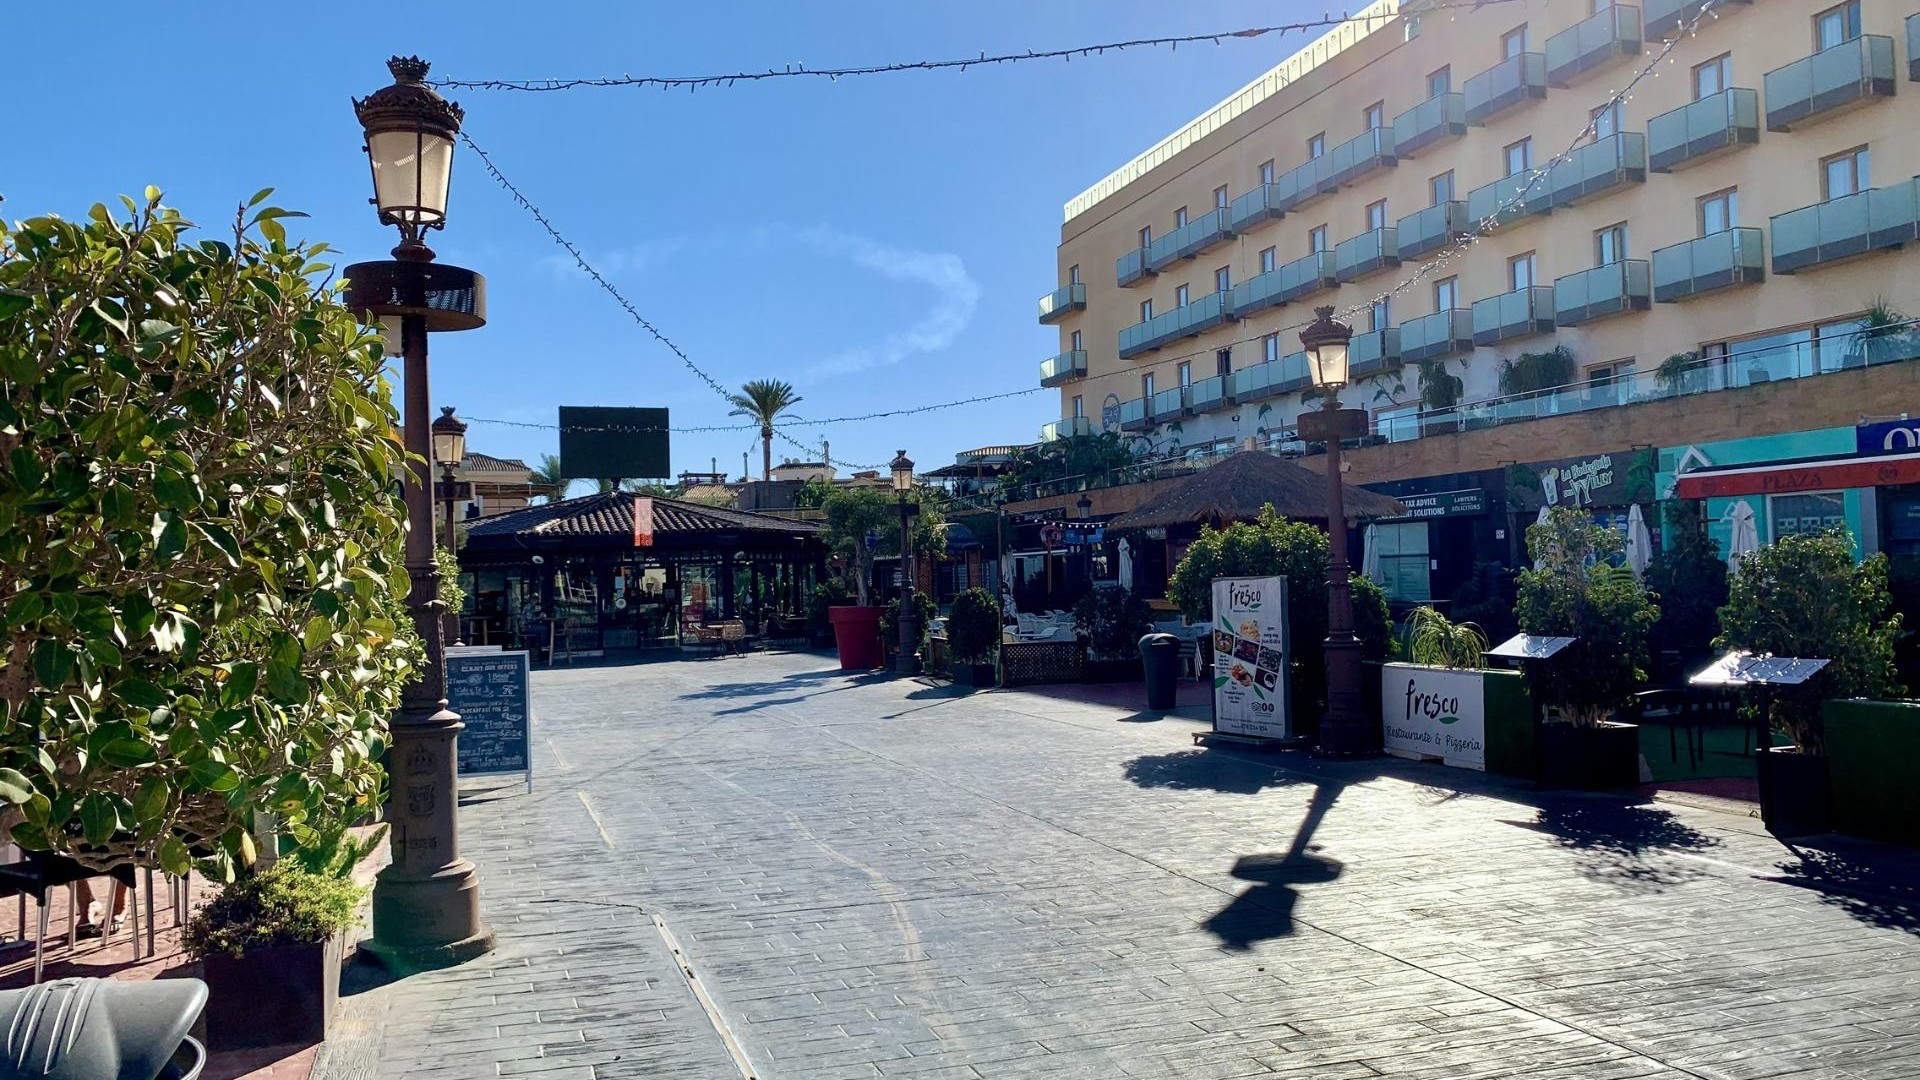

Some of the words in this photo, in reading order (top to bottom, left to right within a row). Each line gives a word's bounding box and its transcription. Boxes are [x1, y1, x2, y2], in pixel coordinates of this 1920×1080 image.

[1763, 473, 1824, 489] PLAZA
[1416, 498, 1437, 507] ADVICE
[1454, 495, 1477, 503] LAWYERS
[1414, 506, 1445, 517] SOLUTIONS
[1451, 503, 1481, 512] SOLICITORS
[1405, 678, 1458, 720] fresco
[1385, 725, 1432, 744] Restaurante
[1435, 732, 1442, 745] &
[1445, 734, 1481, 752] Pizzeria
